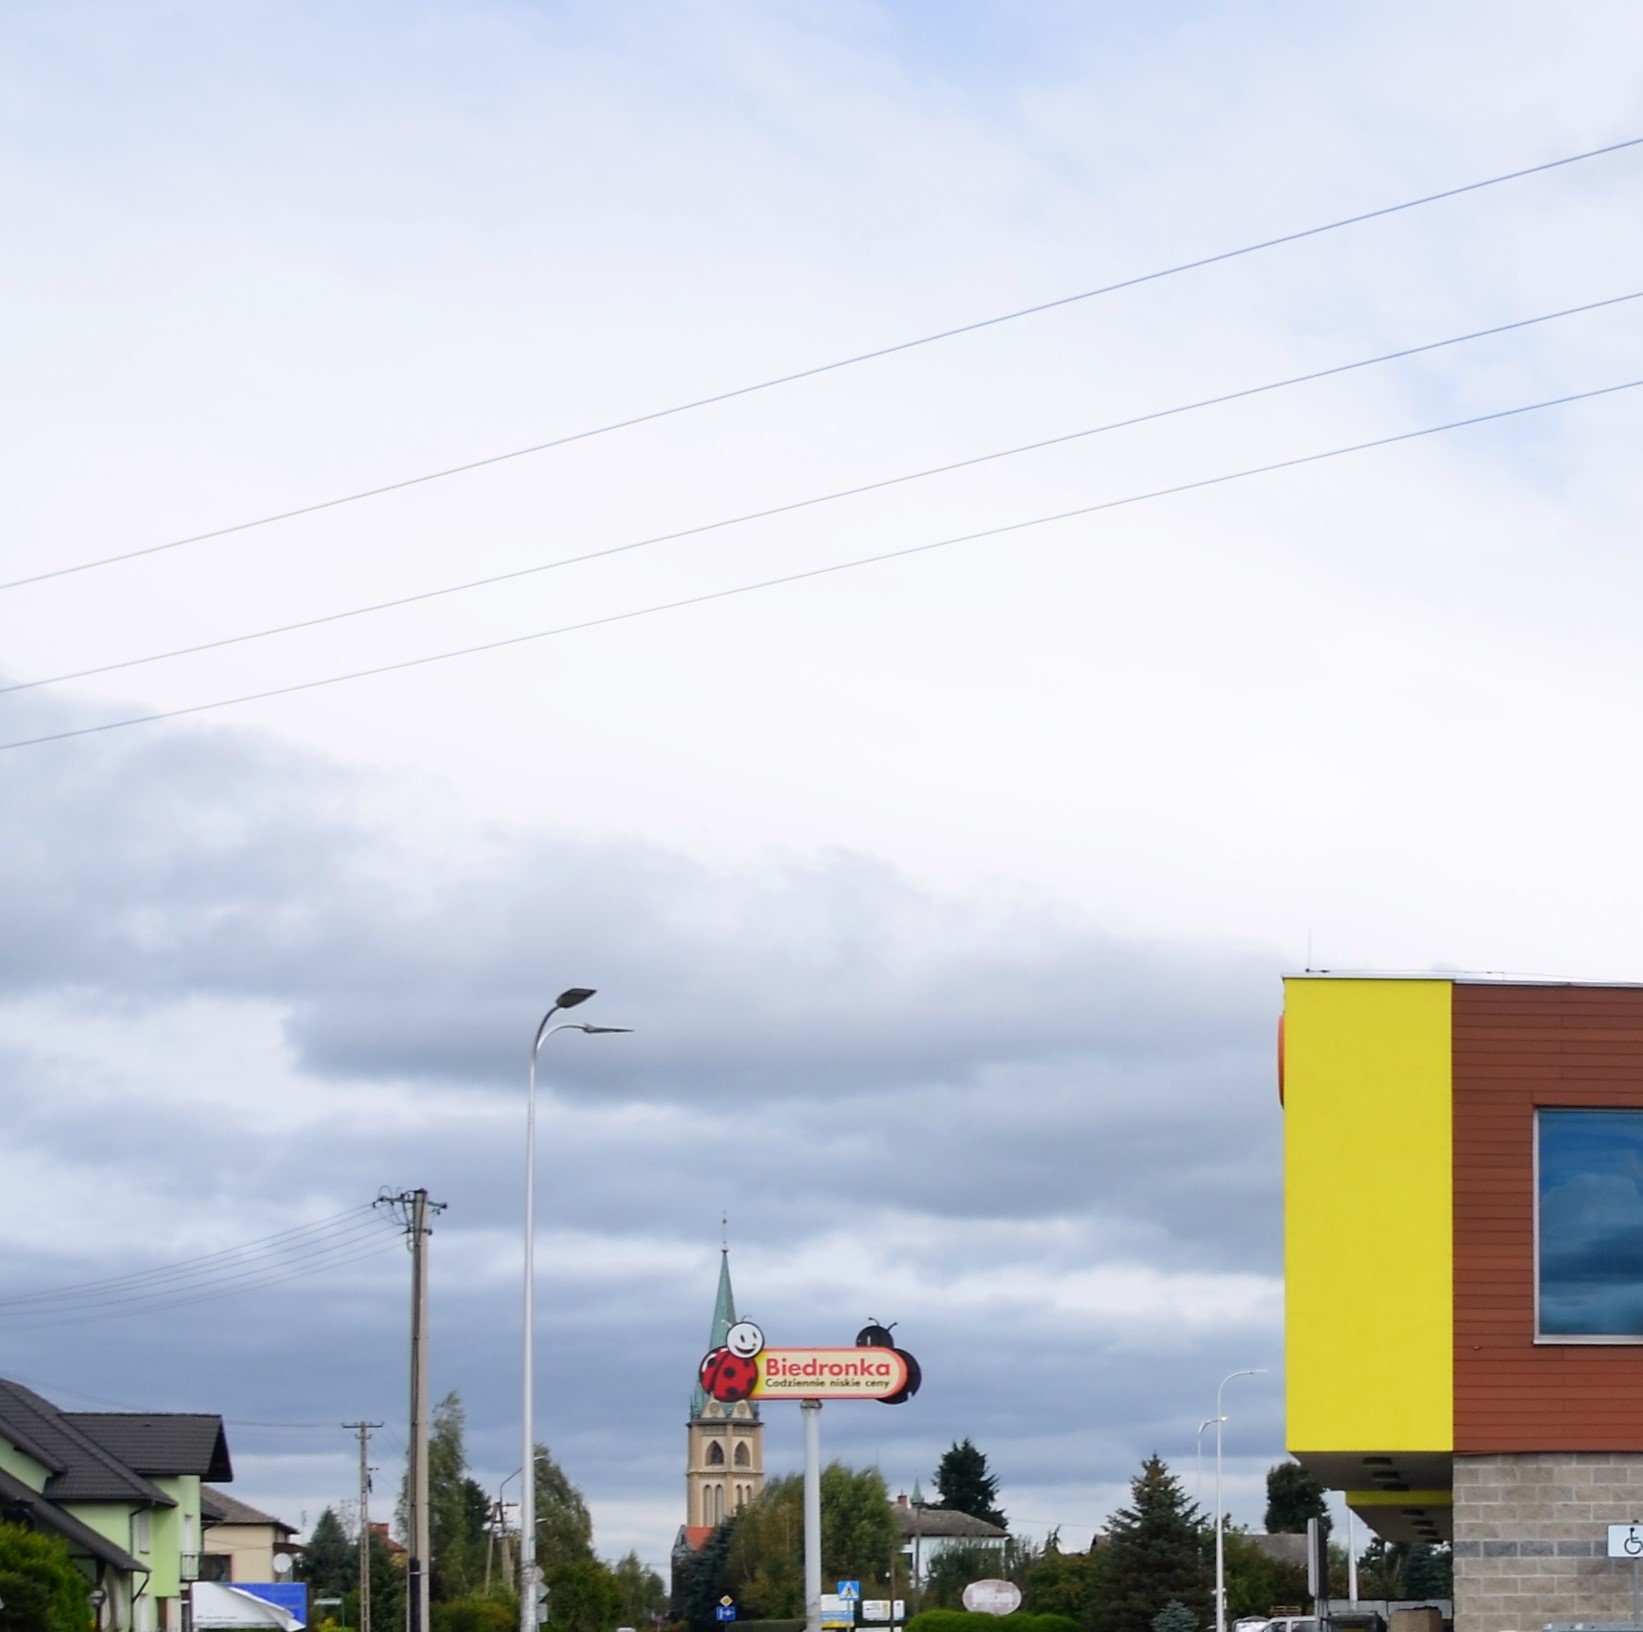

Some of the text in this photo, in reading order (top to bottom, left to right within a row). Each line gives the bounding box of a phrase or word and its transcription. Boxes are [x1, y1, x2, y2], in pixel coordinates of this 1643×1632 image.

[765, 1358, 891, 1377] Biedronka
[765, 1378, 890, 1389] Codziennie niskie ceny
